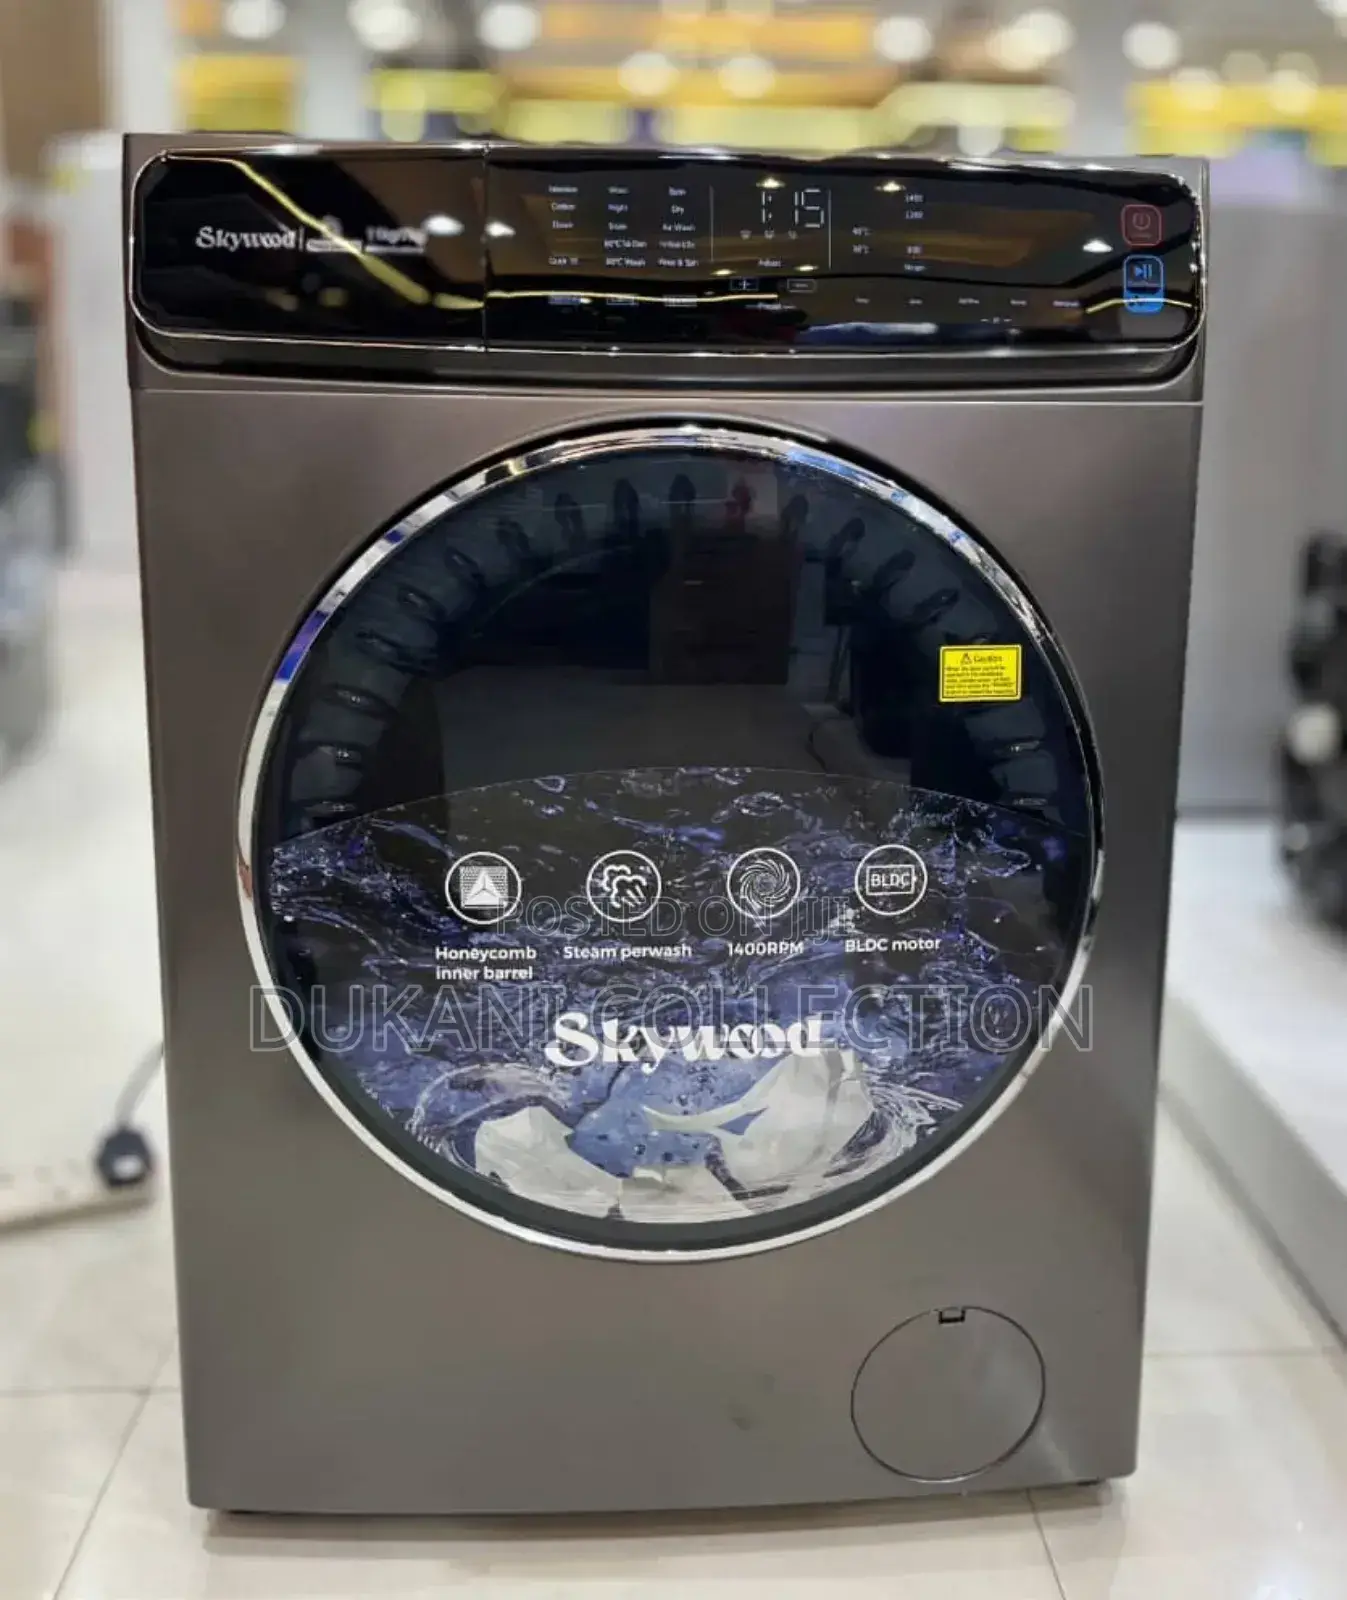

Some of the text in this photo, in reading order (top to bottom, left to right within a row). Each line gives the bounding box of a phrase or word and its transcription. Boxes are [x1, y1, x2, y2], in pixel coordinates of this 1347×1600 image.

[195, 225, 298, 252] Skywood
[870, 872, 911, 889] BLDC
[562, 944, 693, 964] Steam perwash
[727, 941, 805, 957] 1400RPM
[844, 938, 943, 953] BLDC motor
[434, 946, 538, 963] Honeycomb
[435, 966, 534, 981] inner barrel
[543, 1011, 826, 1077] Skywood
